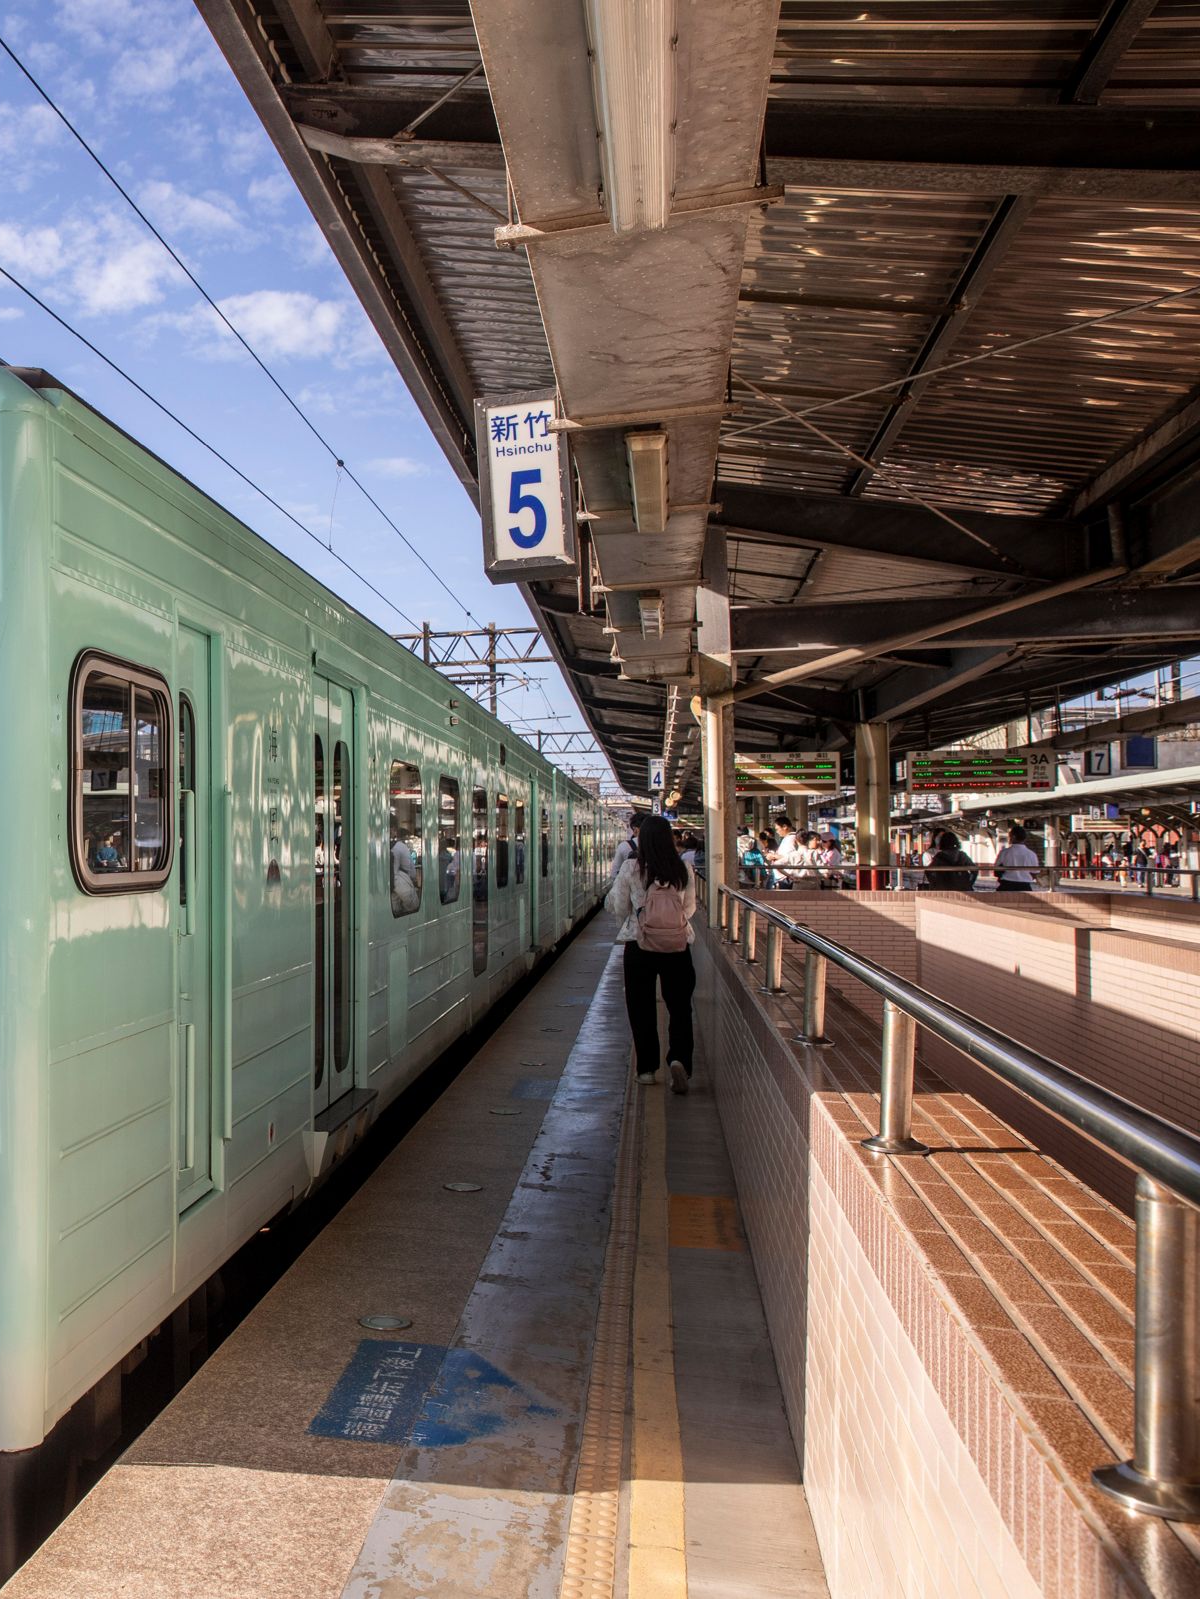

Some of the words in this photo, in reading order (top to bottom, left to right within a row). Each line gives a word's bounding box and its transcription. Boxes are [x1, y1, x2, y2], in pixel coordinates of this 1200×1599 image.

[490, 410, 552, 443] 新竹
[495, 442, 552, 458] Hsinchu
[508, 468, 547, 550] 5
[1029, 753, 1050, 765] 3A
[1095, 753, 1105, 771] 7
[653, 771, 662, 787] 4
[654, 803, 660, 813] 3
